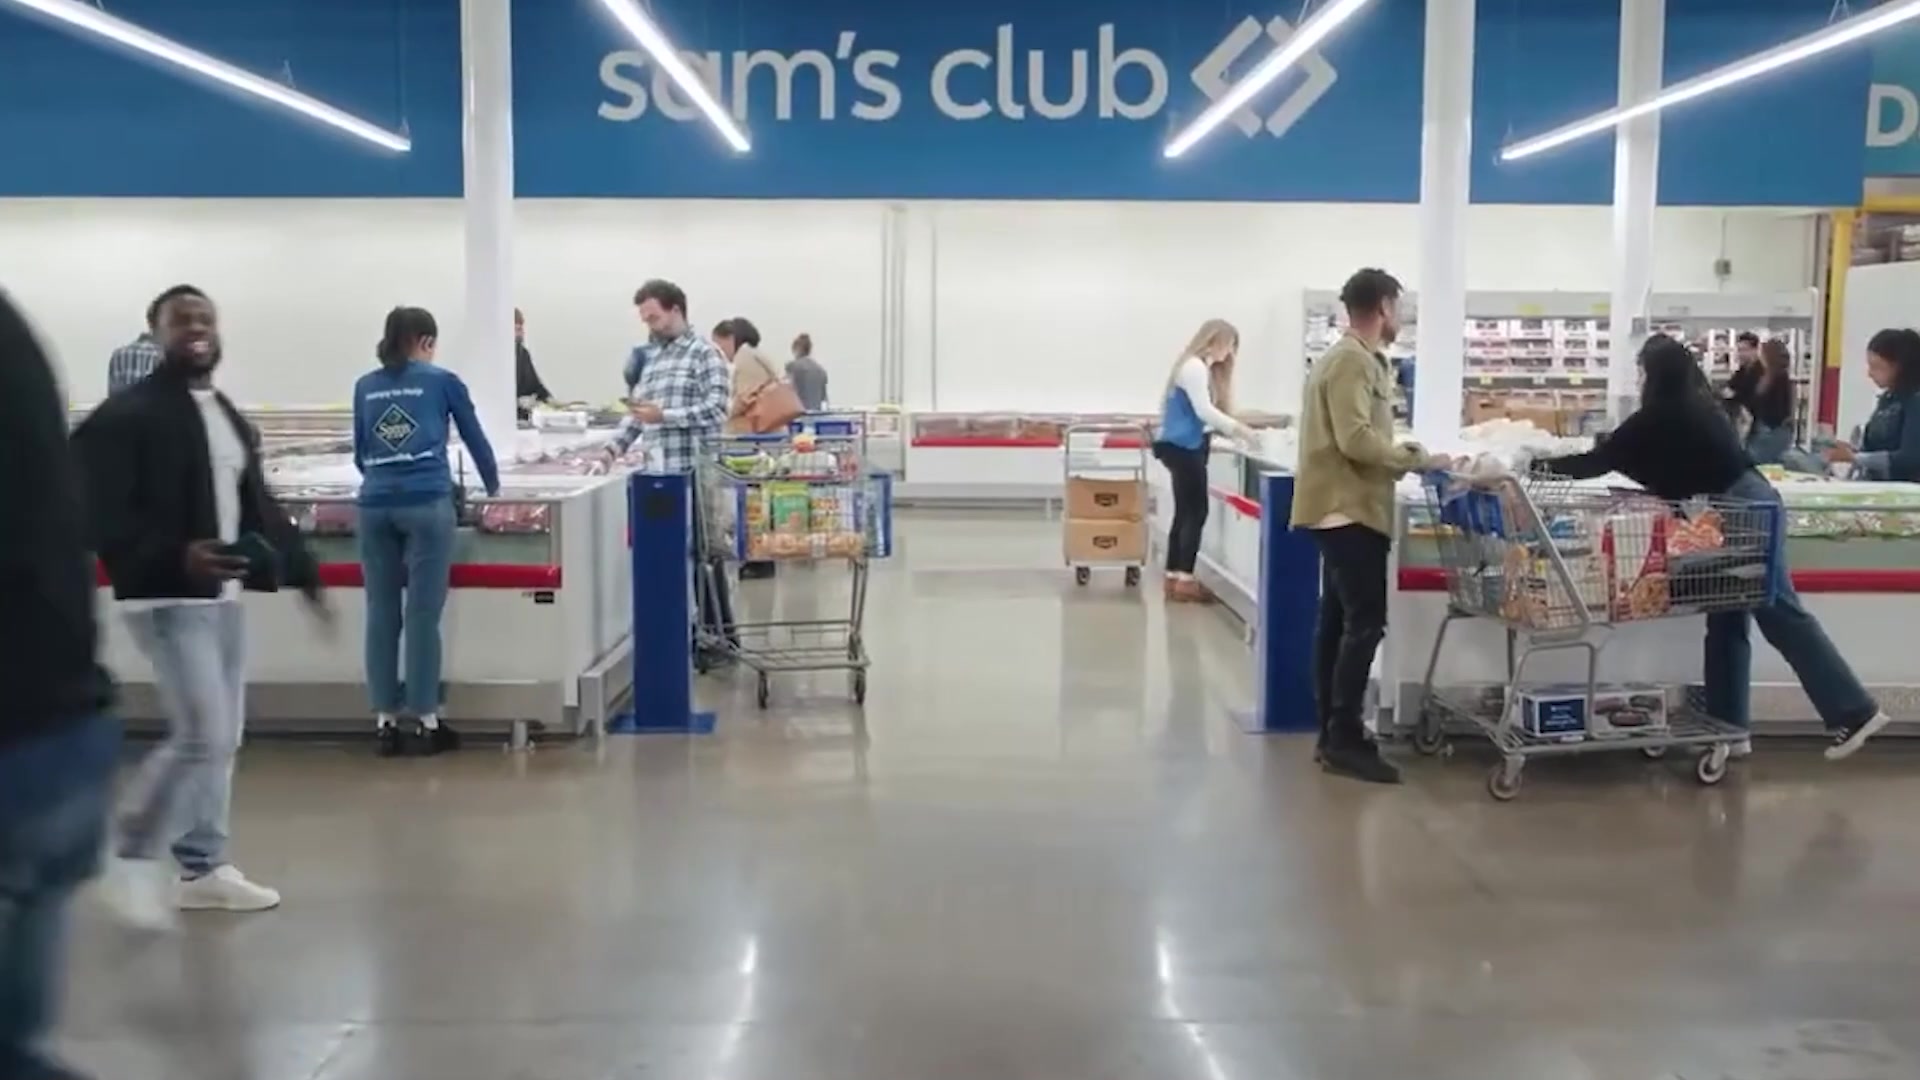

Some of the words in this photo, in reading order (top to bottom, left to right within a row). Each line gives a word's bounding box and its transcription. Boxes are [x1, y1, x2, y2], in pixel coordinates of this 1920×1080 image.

[598, 31, 901, 121] sam's
[930, 23, 1168, 120] club
[1865, 84, 1920, 147] D
